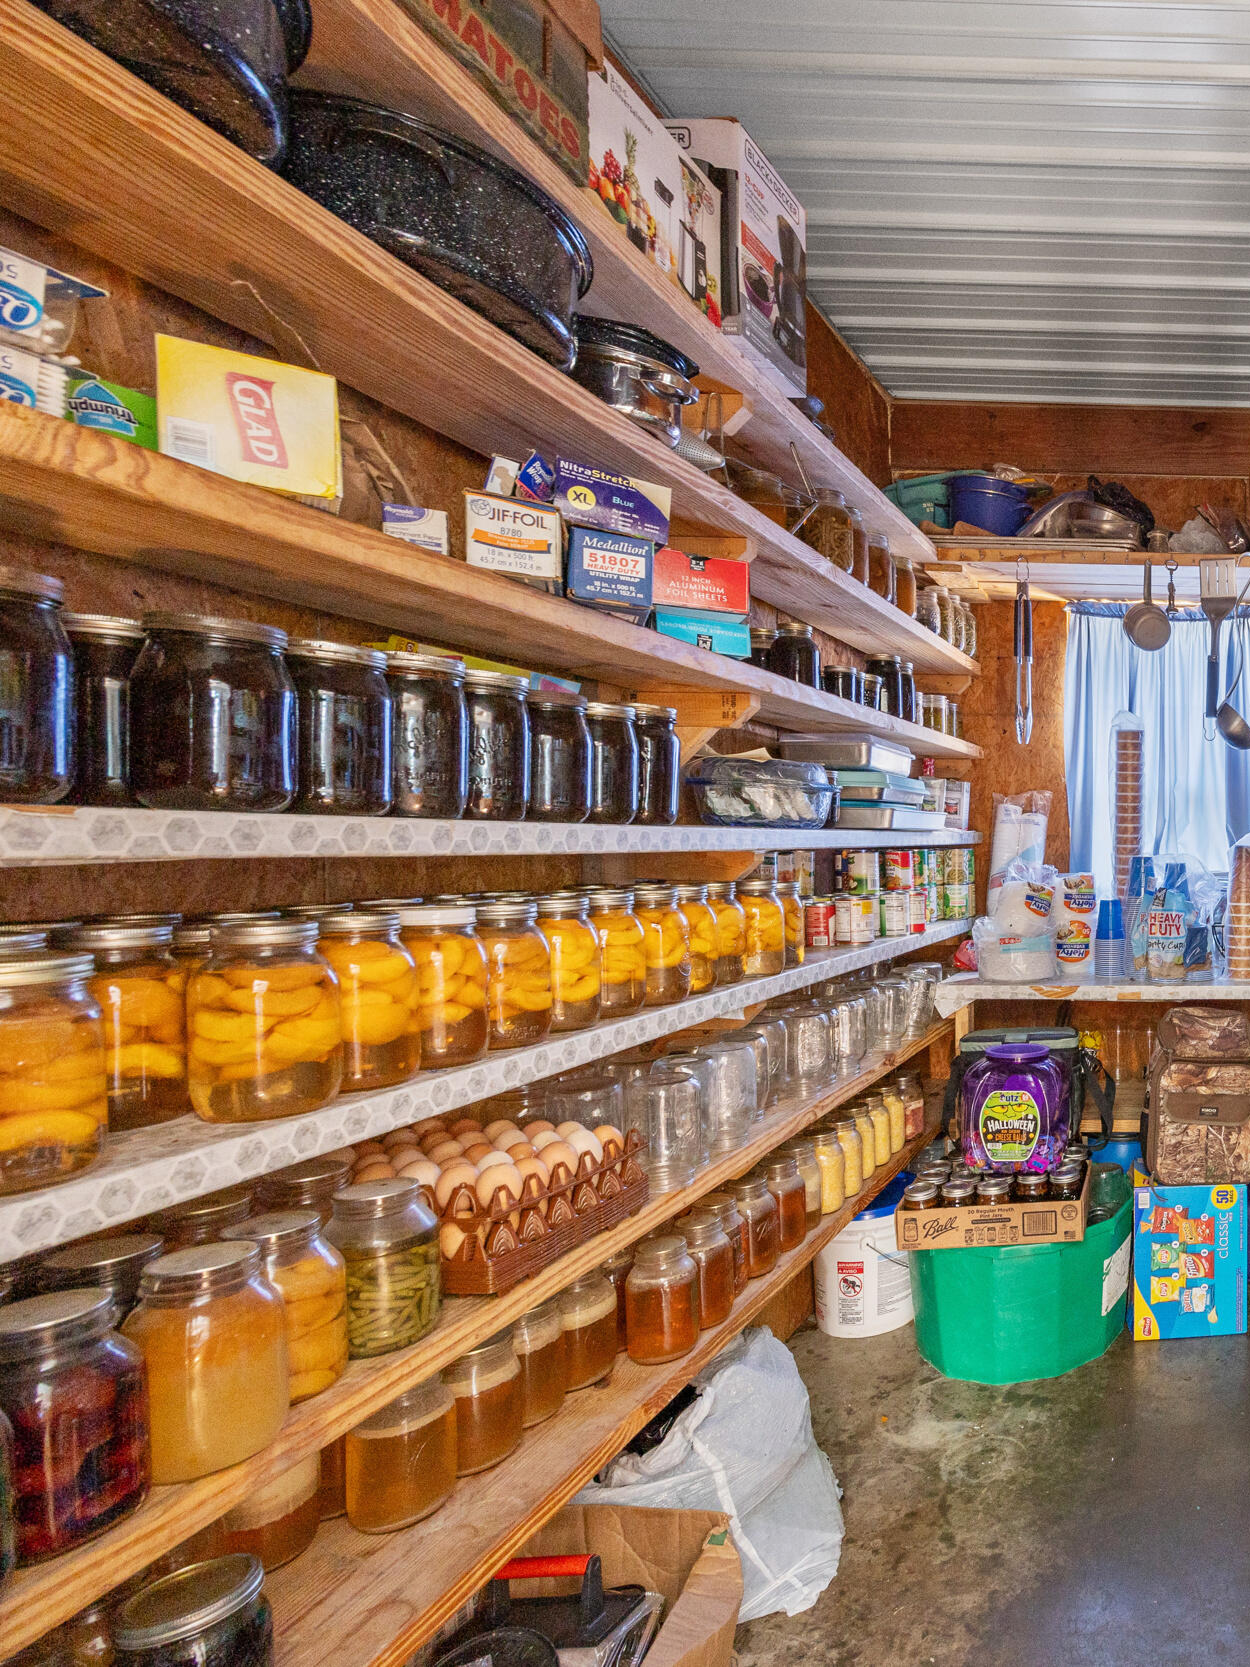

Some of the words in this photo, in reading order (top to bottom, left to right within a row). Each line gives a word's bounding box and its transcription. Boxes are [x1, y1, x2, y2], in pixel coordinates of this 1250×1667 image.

[427, 0, 580, 158] MATOES
[69, 398, 139, 426] Triumph
[232, 380, 278, 463] GLAD
[527, 466, 543, 484] Wrap
[560, 460, 637, 488] NitraStretch
[572, 490, 592, 506] XL
[489, 507, 548, 530] JIF-FOIL
[500, 527, 522, 538] 8780
[582, 536, 647, 556] Medallion
[480, 556, 496, 564] 45.7
[514, 561, 534, 570] 152.4
[513, 552, 527, 560] 500
[589, 552, 640, 569] 51807
[587, 563, 616, 574] HEAVY
[617, 567, 641, 576] DUTY
[589, 571, 618, 580] UTILITY
[619, 575, 640, 583] WRAP
[666, 588, 689, 598] FOIL
[693, 592, 728, 602] SHEETS
[669, 581, 725, 595] ALUMINUM
[1071, 899, 1093, 908] Hefty
[1149, 912, 1184, 924] HEAVY
[1149, 923, 1181, 936] DUTY
[1148, 939, 1166, 951] arty
[1060, 949, 1085, 958] Hefty
[987, 1120, 1036, 1133] HALLOWEEN
[995, 1133, 1012, 1142] CHEESE
[1216, 1189, 1229, 1204] 50
[923, 1216, 960, 1240] Ball
[1217, 1212, 1229, 1259] classic
[1185, 1256, 1198, 1278] Fritos
[1184, 1289, 1193, 1313] RUFFLES
